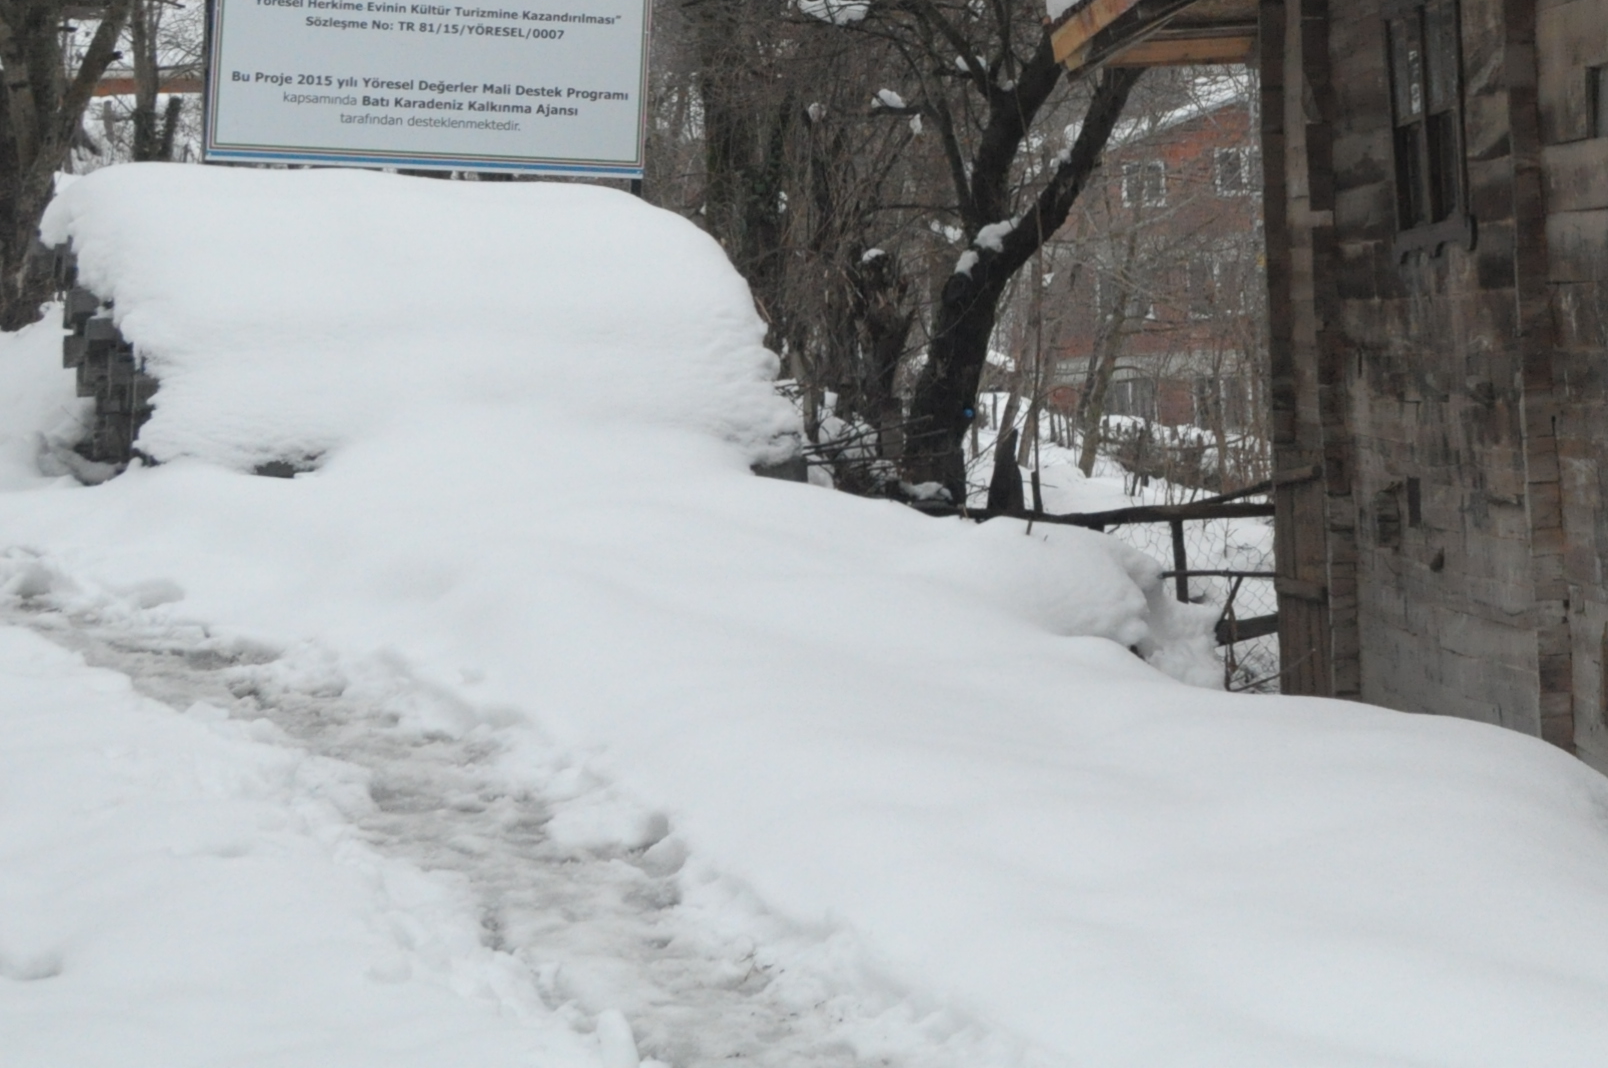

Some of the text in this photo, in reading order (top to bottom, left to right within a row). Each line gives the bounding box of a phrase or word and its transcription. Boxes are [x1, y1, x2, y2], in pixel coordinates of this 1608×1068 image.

[367, 1, 407, 13] Evinin
[411, 3, 451, 16] Kültür
[455, 6, 519, 19] Turizmine
[305, 16, 565, 40] Sözleşme No: TR 81/15/YÖRESEL/0007
[231, 70, 629, 102] Bu Proje 2015 yılı Yöresel Değerler Mali Destek Programı
[283, 91, 578, 117] kapsamında Batı Karadeniz Kalkınma Ajansı
[340, 112, 521, 132] tarafından desteklenmektedir.
